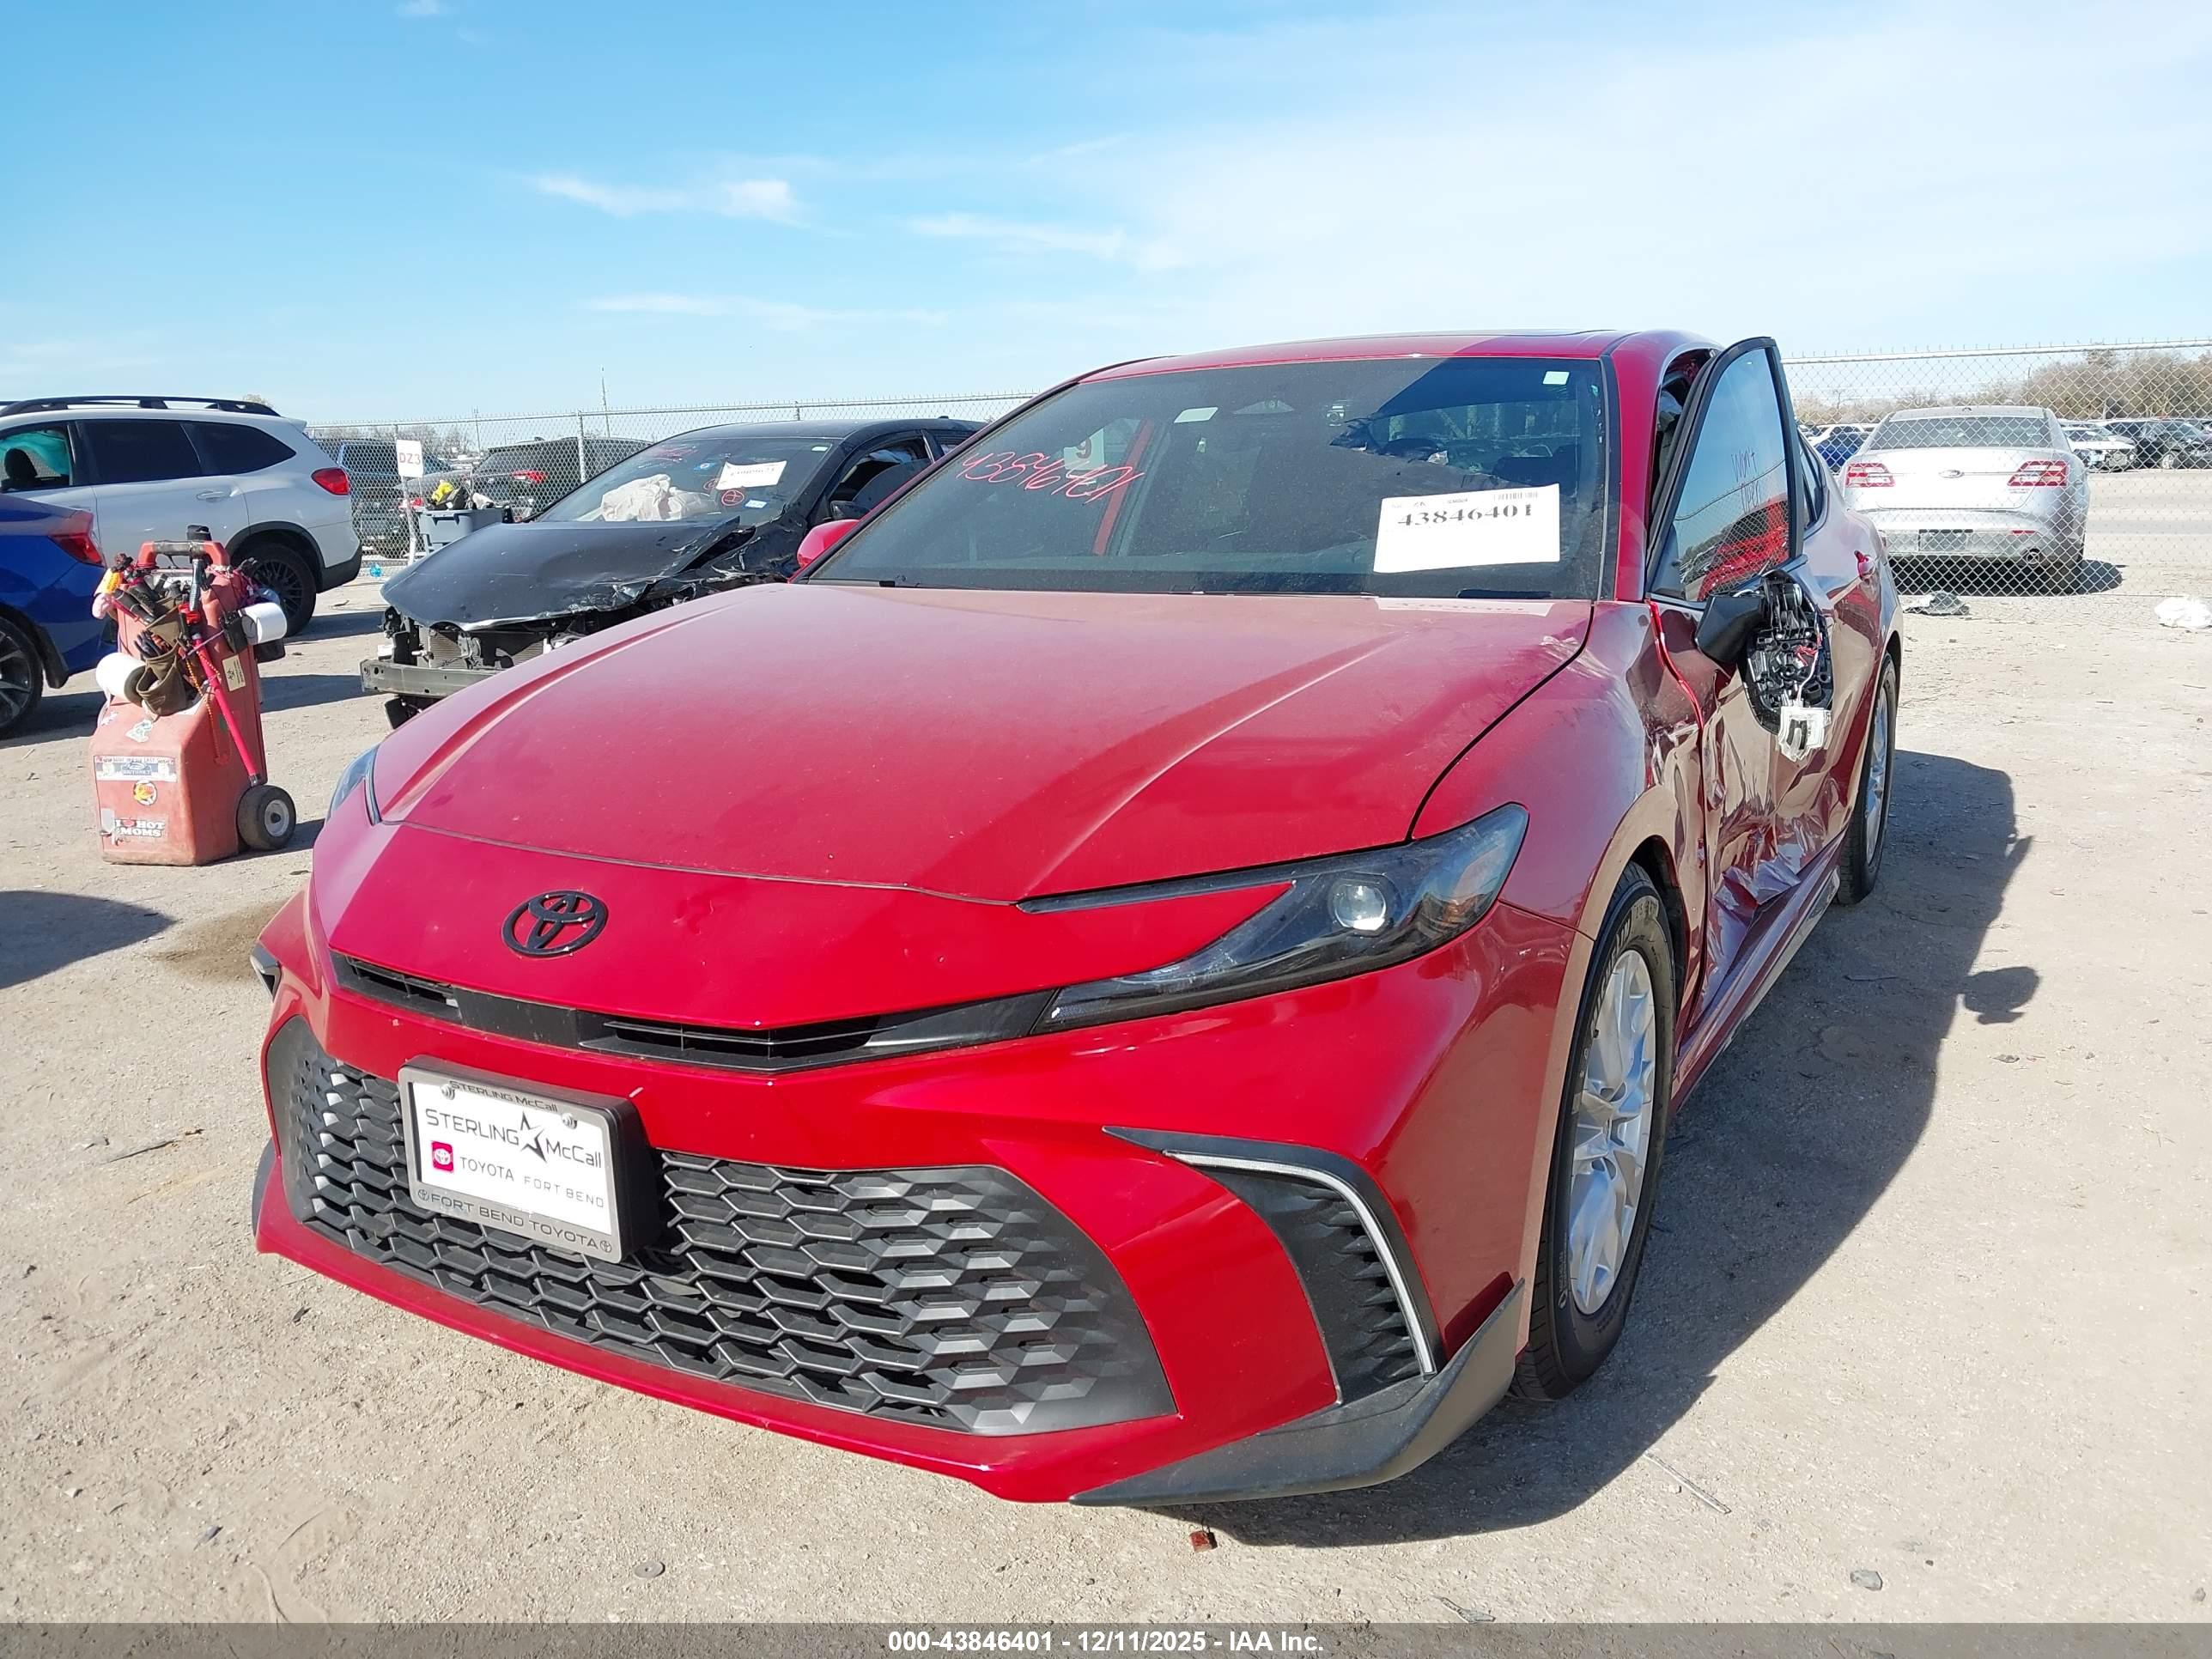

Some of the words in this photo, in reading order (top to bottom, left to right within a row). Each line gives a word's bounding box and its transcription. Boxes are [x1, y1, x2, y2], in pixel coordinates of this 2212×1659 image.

[398, 452, 422, 465] DZ3
[1397, 502, 1532, 526] 43846401
[120, 827, 161, 837] MOMS
[136, 820, 165, 830] HOT
[450, 1080, 513, 1102] STERLING
[514, 1096, 559, 1113] McCall
[425, 1108, 520, 1146] STERLING
[545, 1137, 602, 1169] McCall
[459, 1156, 514, 1182] TOYOTA
[523, 1176, 561, 1194] FORT
[565, 1188, 605, 1209] BEND
[430, 1193, 475, 1213] FORT
[478, 1204, 525, 1227] BEND
[528, 1219, 599, 1250] TOYOTA
